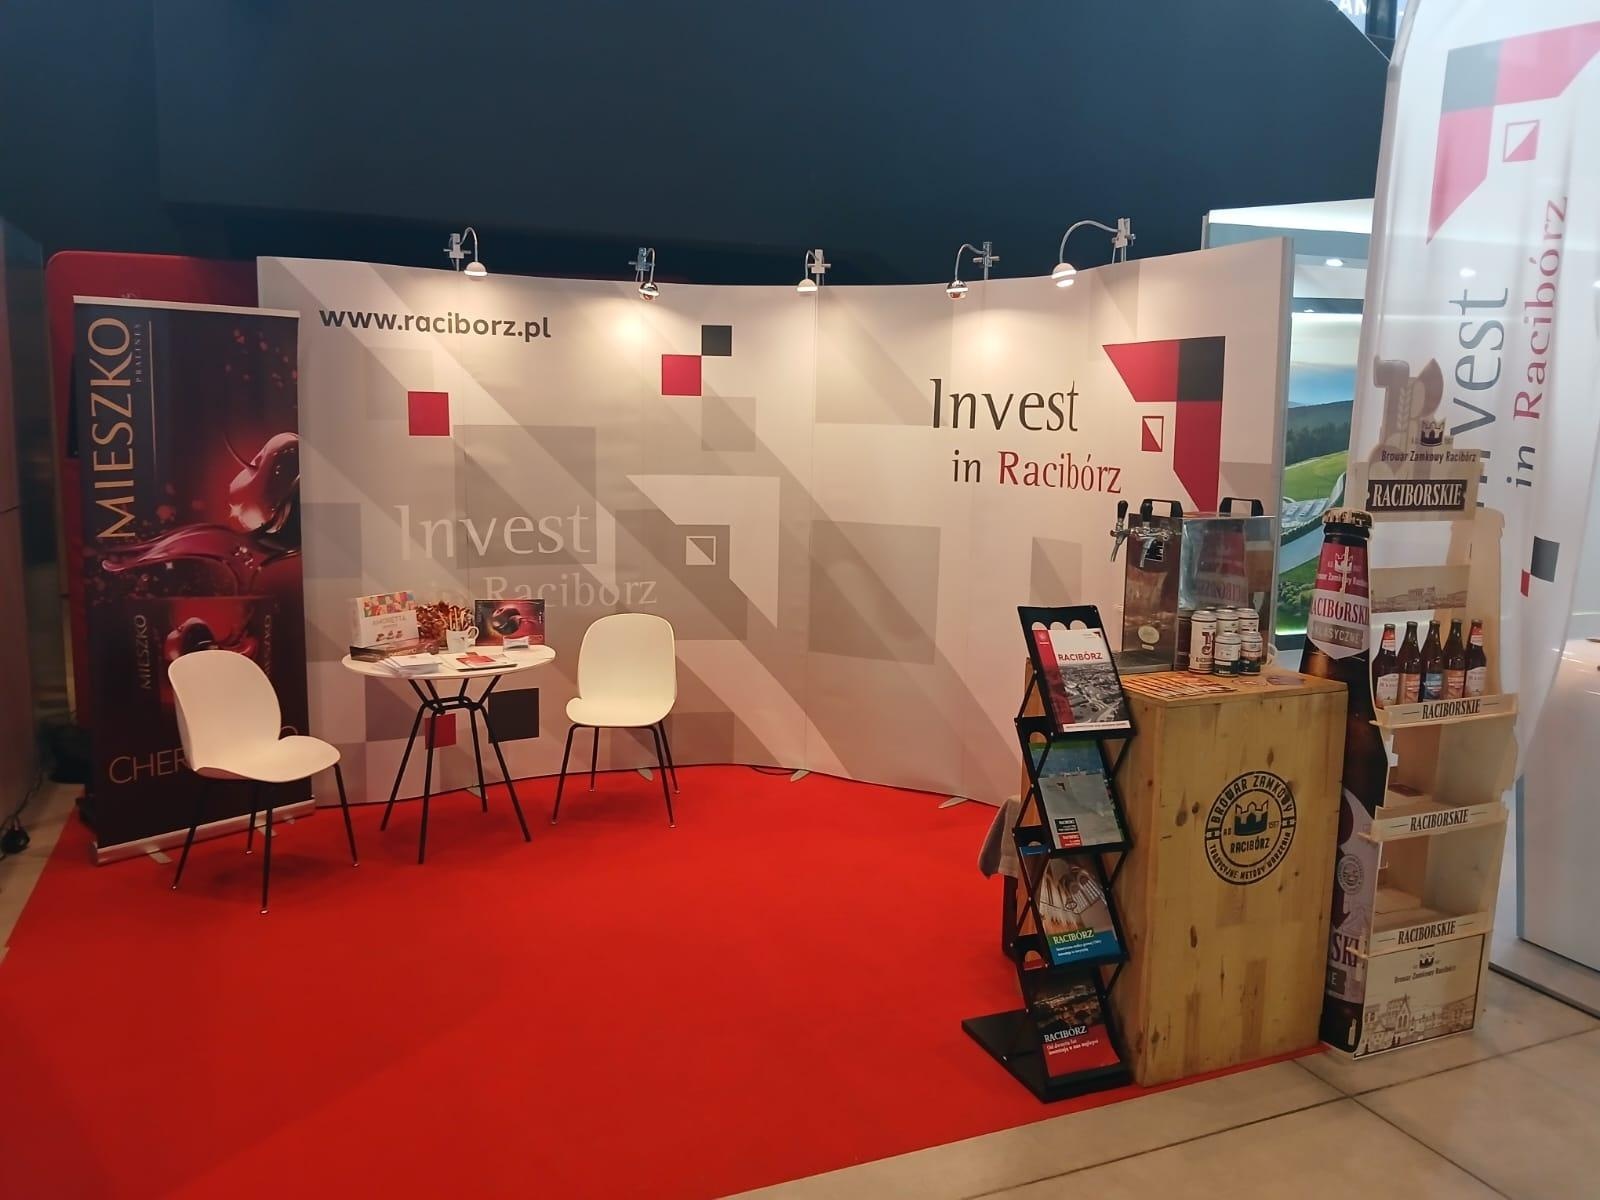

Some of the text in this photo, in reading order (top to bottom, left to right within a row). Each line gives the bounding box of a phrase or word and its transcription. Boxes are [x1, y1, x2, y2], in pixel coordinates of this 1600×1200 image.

[319, 310, 552, 343] www.raciborz.pl
[1506, 196, 1568, 488] in Racibórz
[929, 378, 1079, 432] Invest
[88, 317, 137, 540] MIESZKO
[951, 449, 1122, 494] in Racibórz
[1372, 483, 1462, 507] RACIBORSKIE
[394, 503, 591, 561] Invest
[1311, 597, 1369, 626] ACIBORSKI
[135, 614, 152, 690] MIESZKO
[1057, 650, 1103, 661] RACIBÓRZ
[1422, 699, 1480, 719] RACIBORSKIE
[1211, 775, 1293, 824] BROWAR ZAMKOWY
[1410, 809, 1469, 832] RACIBORSKIE
[1230, 835, 1270, 854] RACIBÓRZ
[1052, 929, 1095, 945] RACIBÓRZ
[1398, 921, 1456, 945] RACIBORSKIE
[1044, 1025, 1088, 1043] RACIBÓRZ
